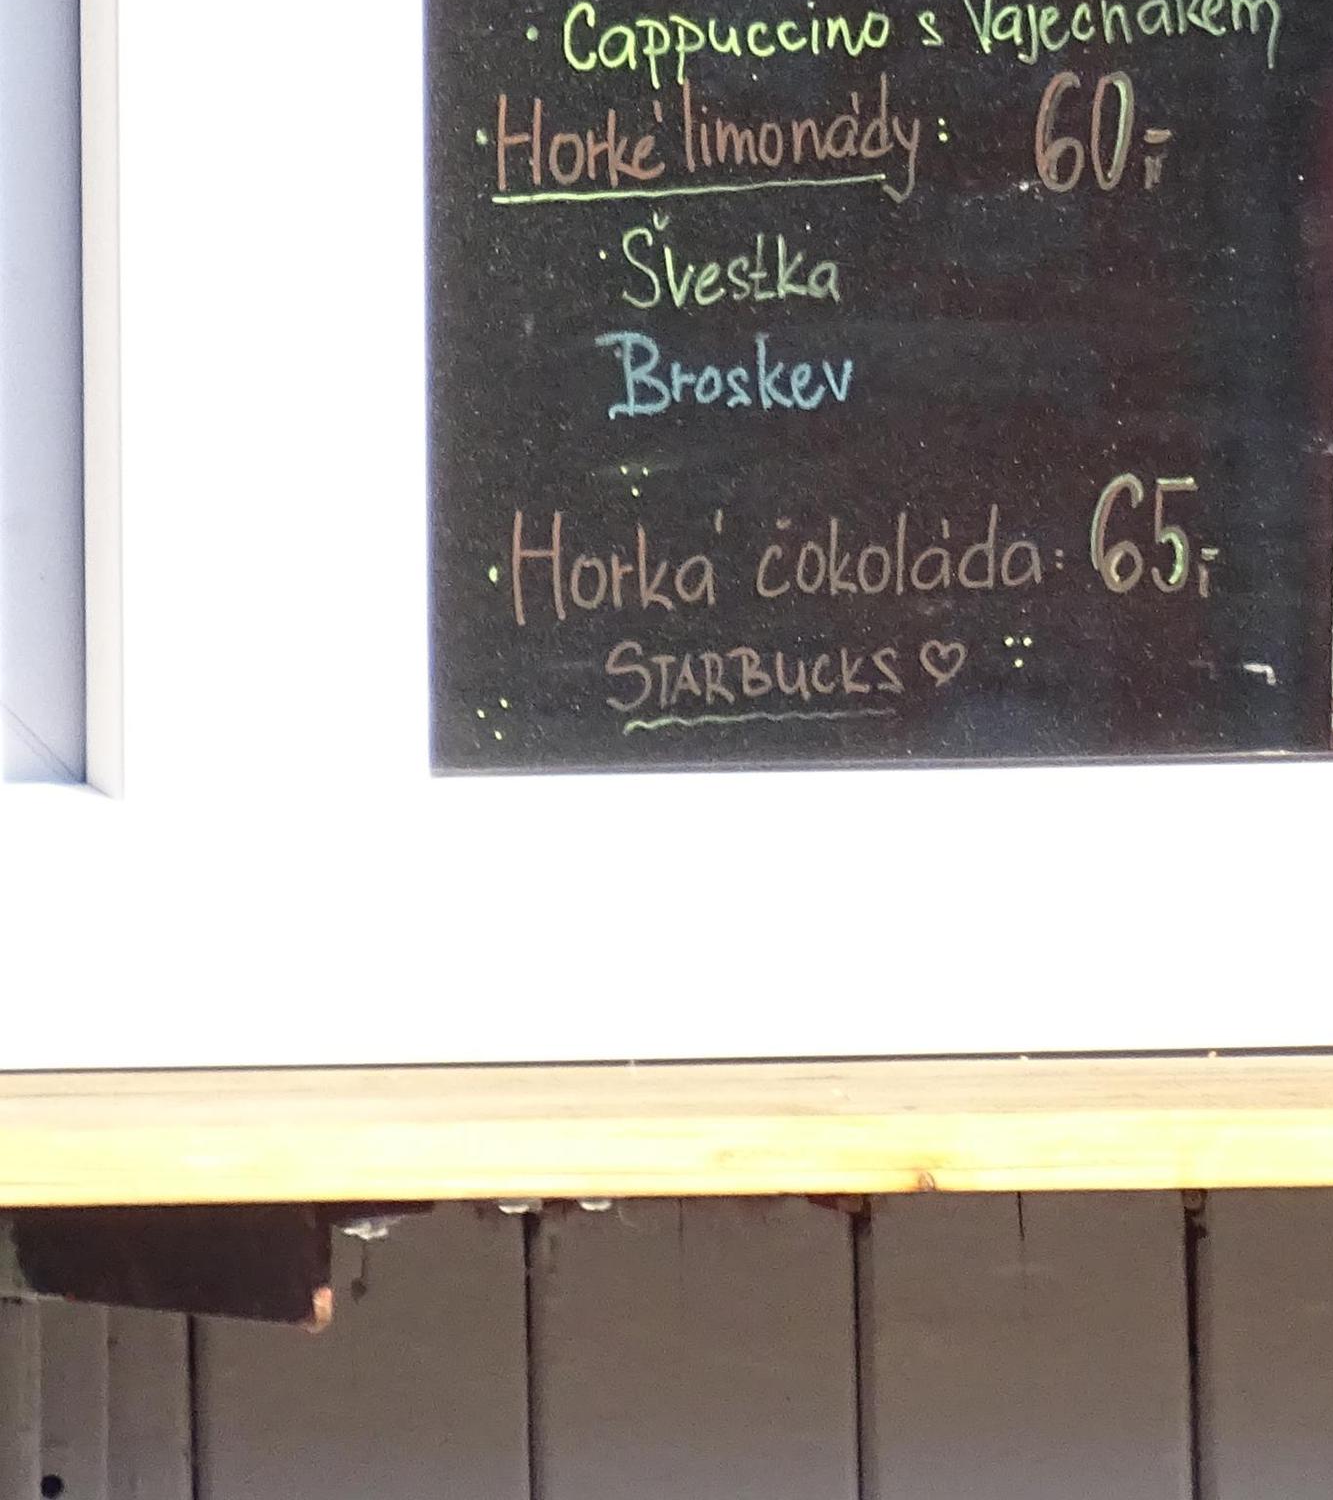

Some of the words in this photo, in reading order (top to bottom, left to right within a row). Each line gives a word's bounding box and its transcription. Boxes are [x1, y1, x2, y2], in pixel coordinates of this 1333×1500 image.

[563, 0, 891, 89] Cappuccino
[917, 10, 944, 47] s
[498, 93, 666, 191] Horké
[620, 212, 842, 309] Švestka
[596, 330, 854, 421] Broskev
[511, 507, 724, 627] Horká
[604, 639, 905, 713] STARBUCKS
